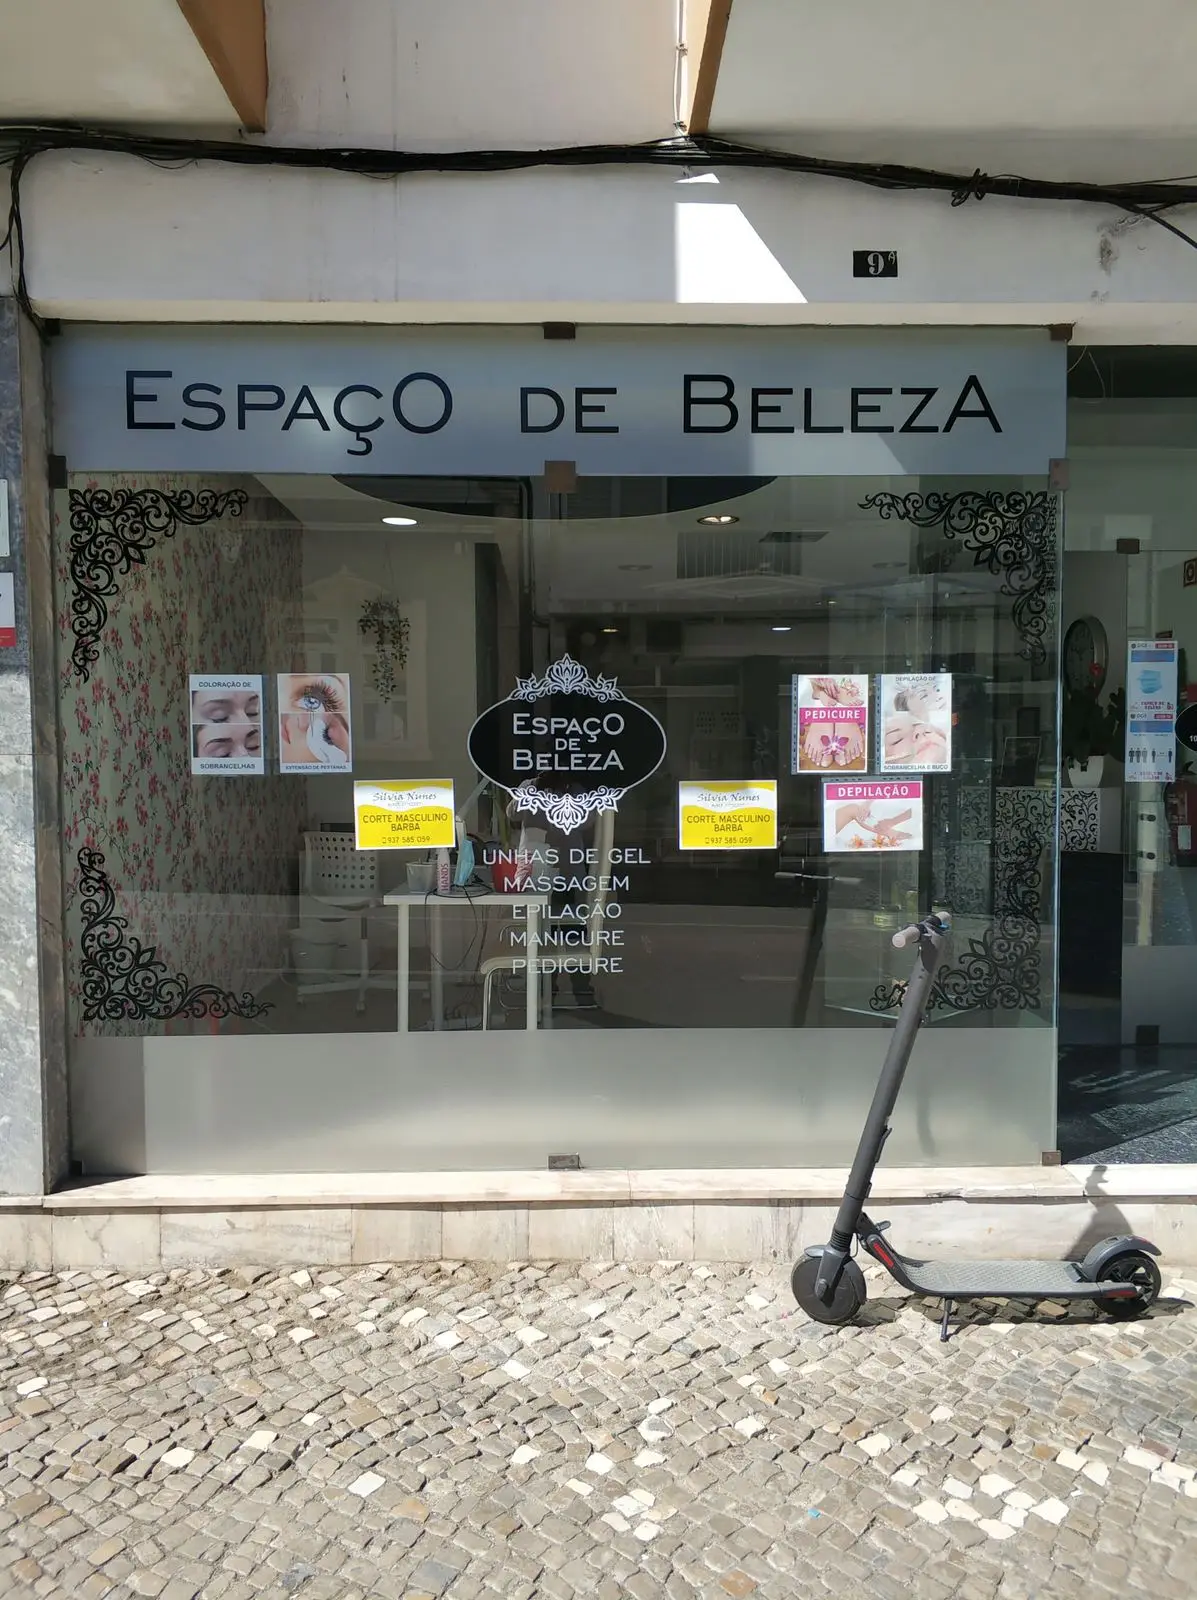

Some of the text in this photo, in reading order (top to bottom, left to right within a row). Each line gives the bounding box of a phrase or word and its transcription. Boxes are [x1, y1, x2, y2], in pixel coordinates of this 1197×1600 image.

[125, 370, 1004, 456] ESPAÇO DE BELEZA
[198, 679, 252, 689] COLORAÇÃO DE
[804, 709, 861, 720] PEDICURE
[512, 712, 625, 743] ESPAÇO
[555, 737, 581, 751] DE
[512, 749, 625, 771] BELEZA
[730, 792, 760, 801] Nunes
[838, 785, 909, 798] DEPILAÇÃO
[362, 812, 448, 823] CORTE MASCULINO
[686, 814, 771, 823] CORTE MASCULINO
[391, 823, 421, 832] BARBA
[714, 824, 743, 832] BARBA
[482, 848, 651, 865] UNHAS DE GEL
[440, 863, 449, 891] HANDS
[503, 875, 630, 891] MASSAGEM
[512, 899, 622, 925] EPILAÇÃO
[510, 930, 625, 946] MANICURE
[512, 957, 624, 974] PEDICURE
